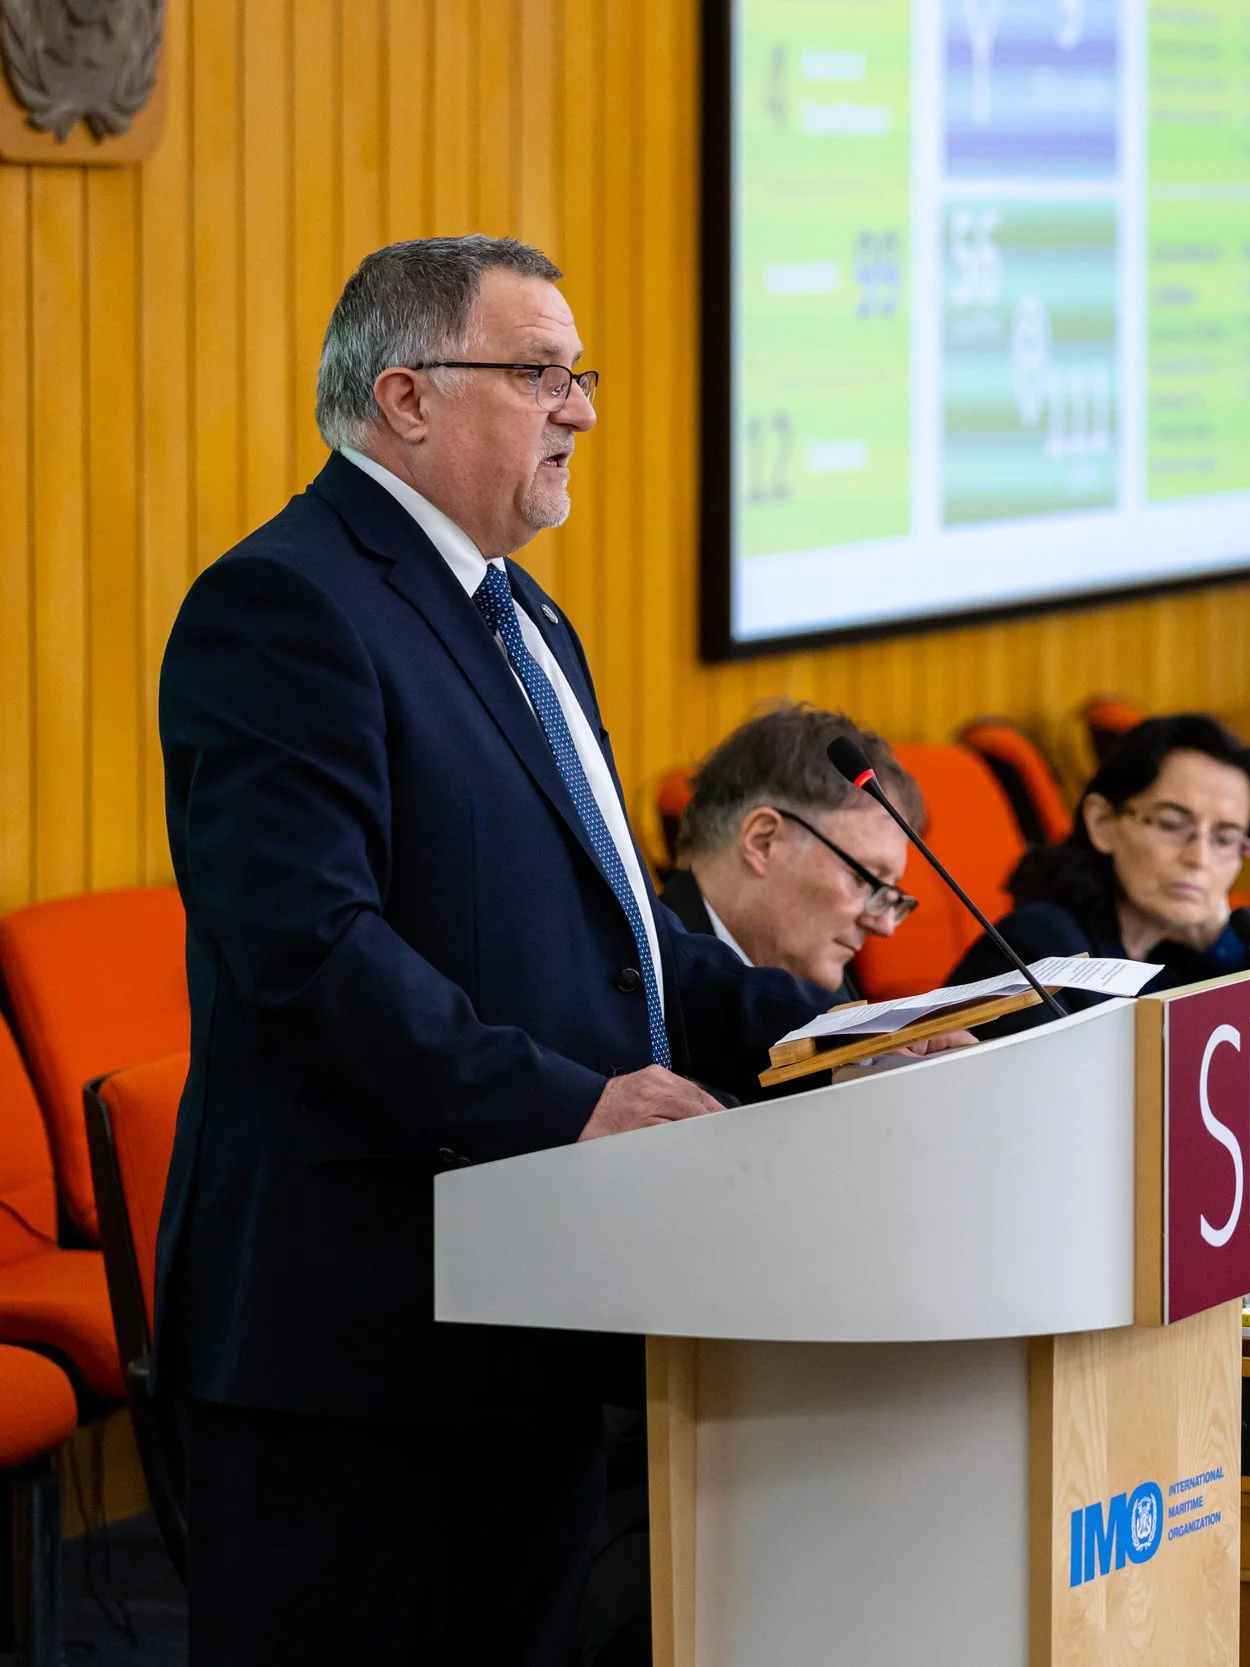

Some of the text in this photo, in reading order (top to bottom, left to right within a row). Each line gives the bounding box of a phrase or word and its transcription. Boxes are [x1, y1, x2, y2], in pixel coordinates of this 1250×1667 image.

[1168, 1467, 1224, 1497] INTERNATIONAL
[1168, 1495, 1203, 1519] MARITIME
[1070, 1481, 1163, 1588] IMO
[1168, 1511, 1221, 1541] ORGANIZATION
